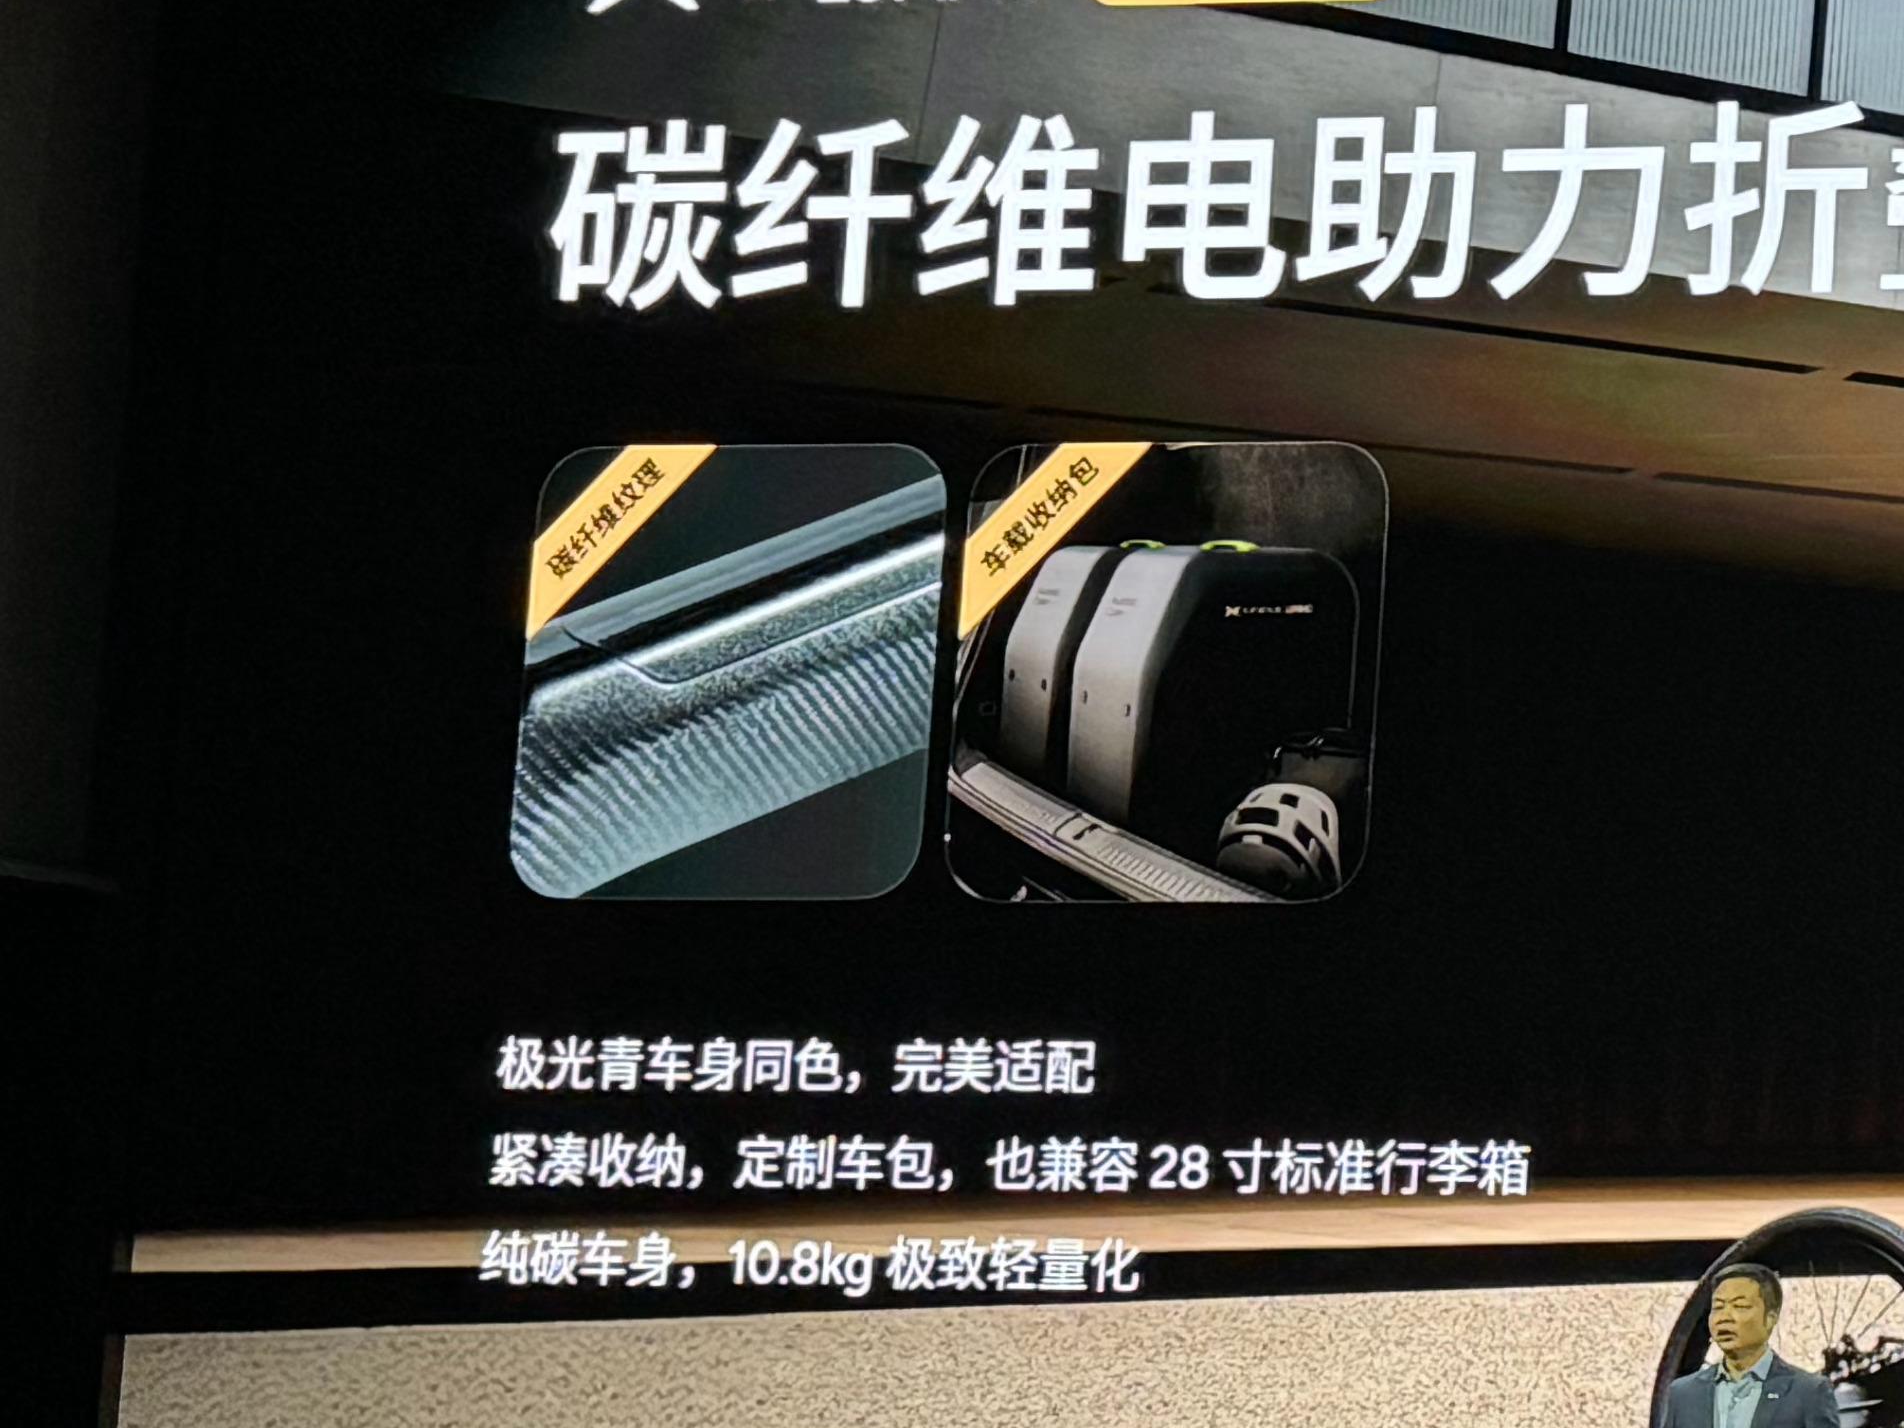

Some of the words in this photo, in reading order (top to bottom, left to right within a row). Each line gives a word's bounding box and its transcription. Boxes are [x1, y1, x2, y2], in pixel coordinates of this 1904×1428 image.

[981, 455, 1100, 577] 车载收纳包
[495, 1034, 1097, 1095] 极光青车身同色，完美适配
[1149, 1143, 1211, 1191] 28
[1222, 1137, 1532, 1197] 寸标准行李箱
[885, 1234, 1142, 1294] 极致轻量化
